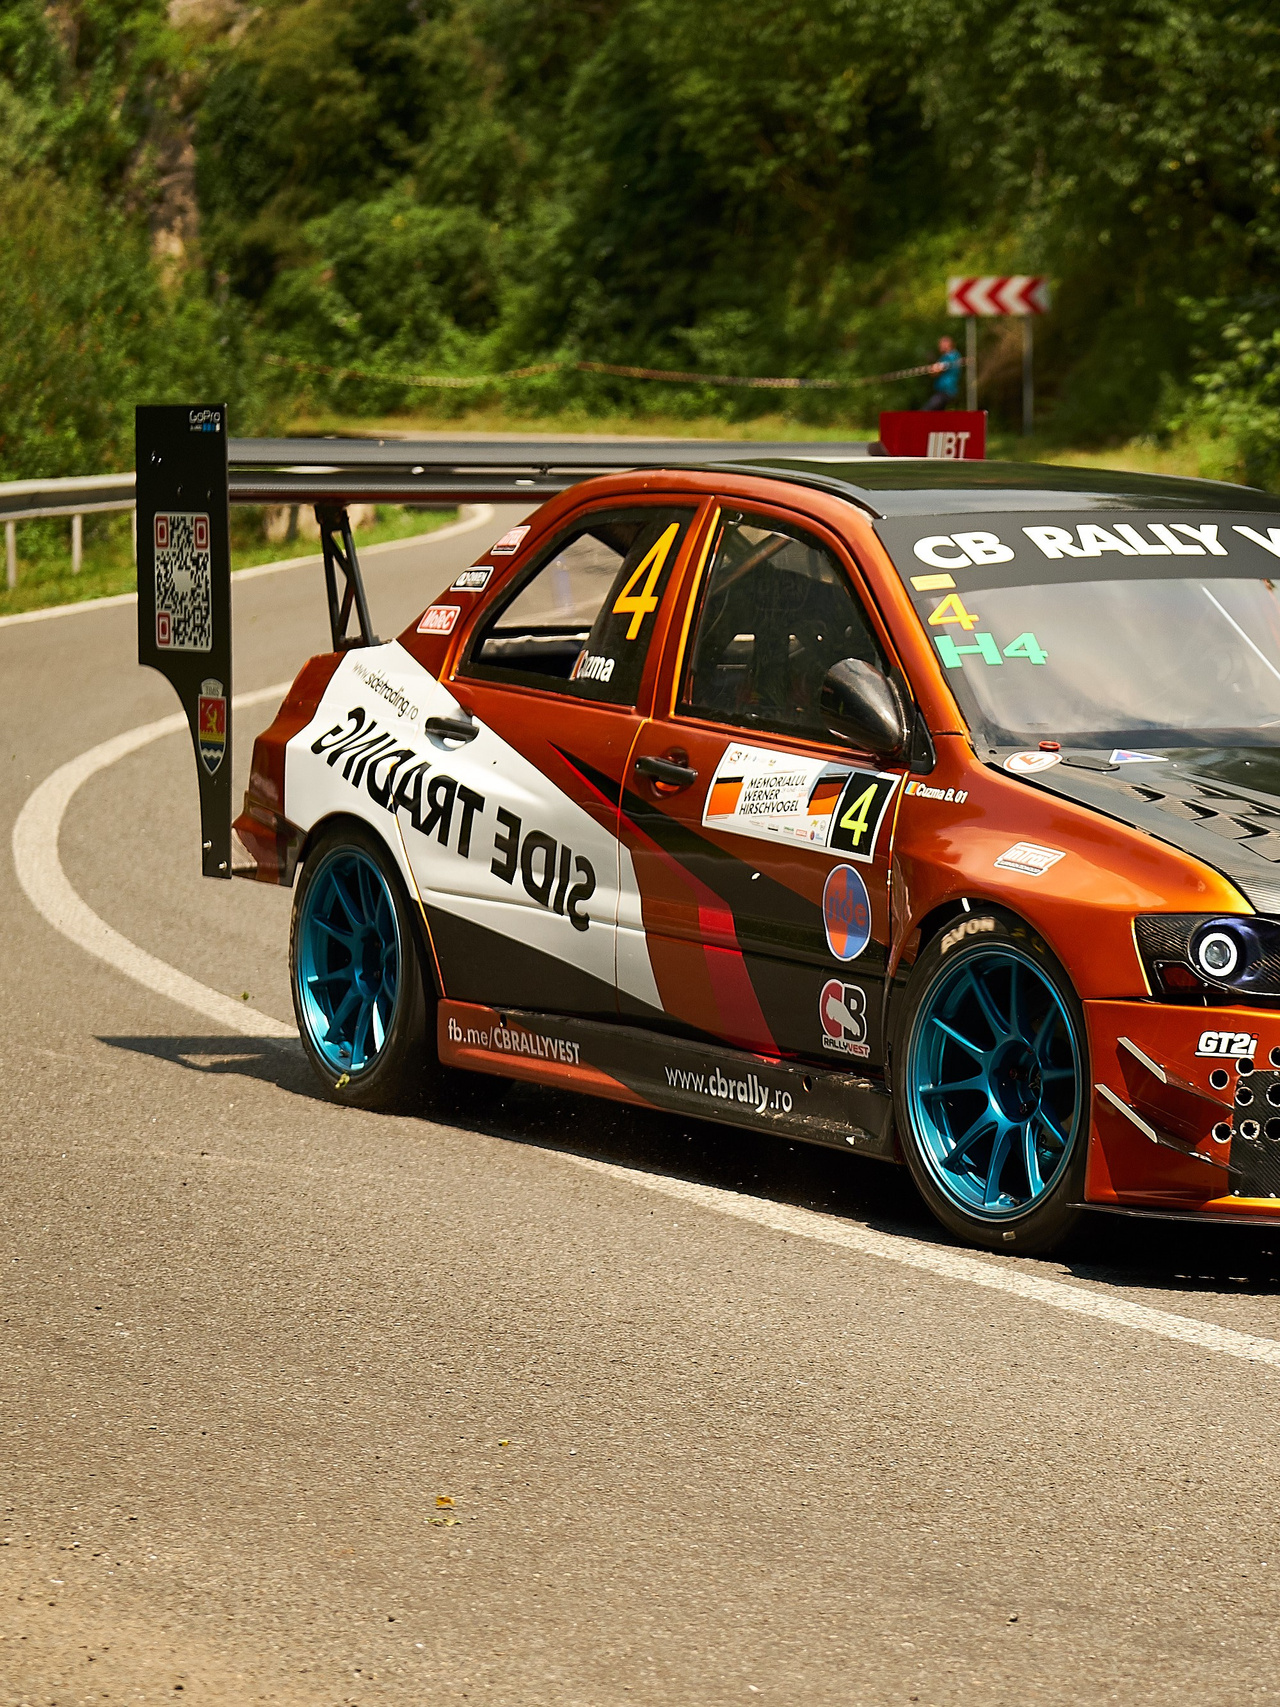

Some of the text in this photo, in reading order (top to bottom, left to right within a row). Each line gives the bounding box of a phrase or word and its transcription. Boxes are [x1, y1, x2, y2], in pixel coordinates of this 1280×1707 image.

[189, 410, 220, 423] GoPro
[913, 531, 1015, 569] CB
[1022, 523, 1228, 559] RALLY
[612, 522, 680, 640] 4
[928, 593, 979, 630] 4
[934, 632, 1049, 669] H4
[744, 788, 780, 801] WERNER
[747, 775, 807, 789] MEMORIALUL
[916, 783, 946, 800] Cuzma
[954, 790, 969, 804] 01
[738, 800, 799, 815] HIRSCHVOGEL
[839, 783, 878, 846] 4
[828, 889, 867, 927] side
[940, 916, 995, 955] AVON
[448, 1018, 580, 1065] fb.me/CBRALLYVEST
[823, 1037, 869, 1057] RALLYVEST
[1198, 1031, 1258, 1055] GT2i
[664, 1066, 793, 1113] www.cbrally.ro
